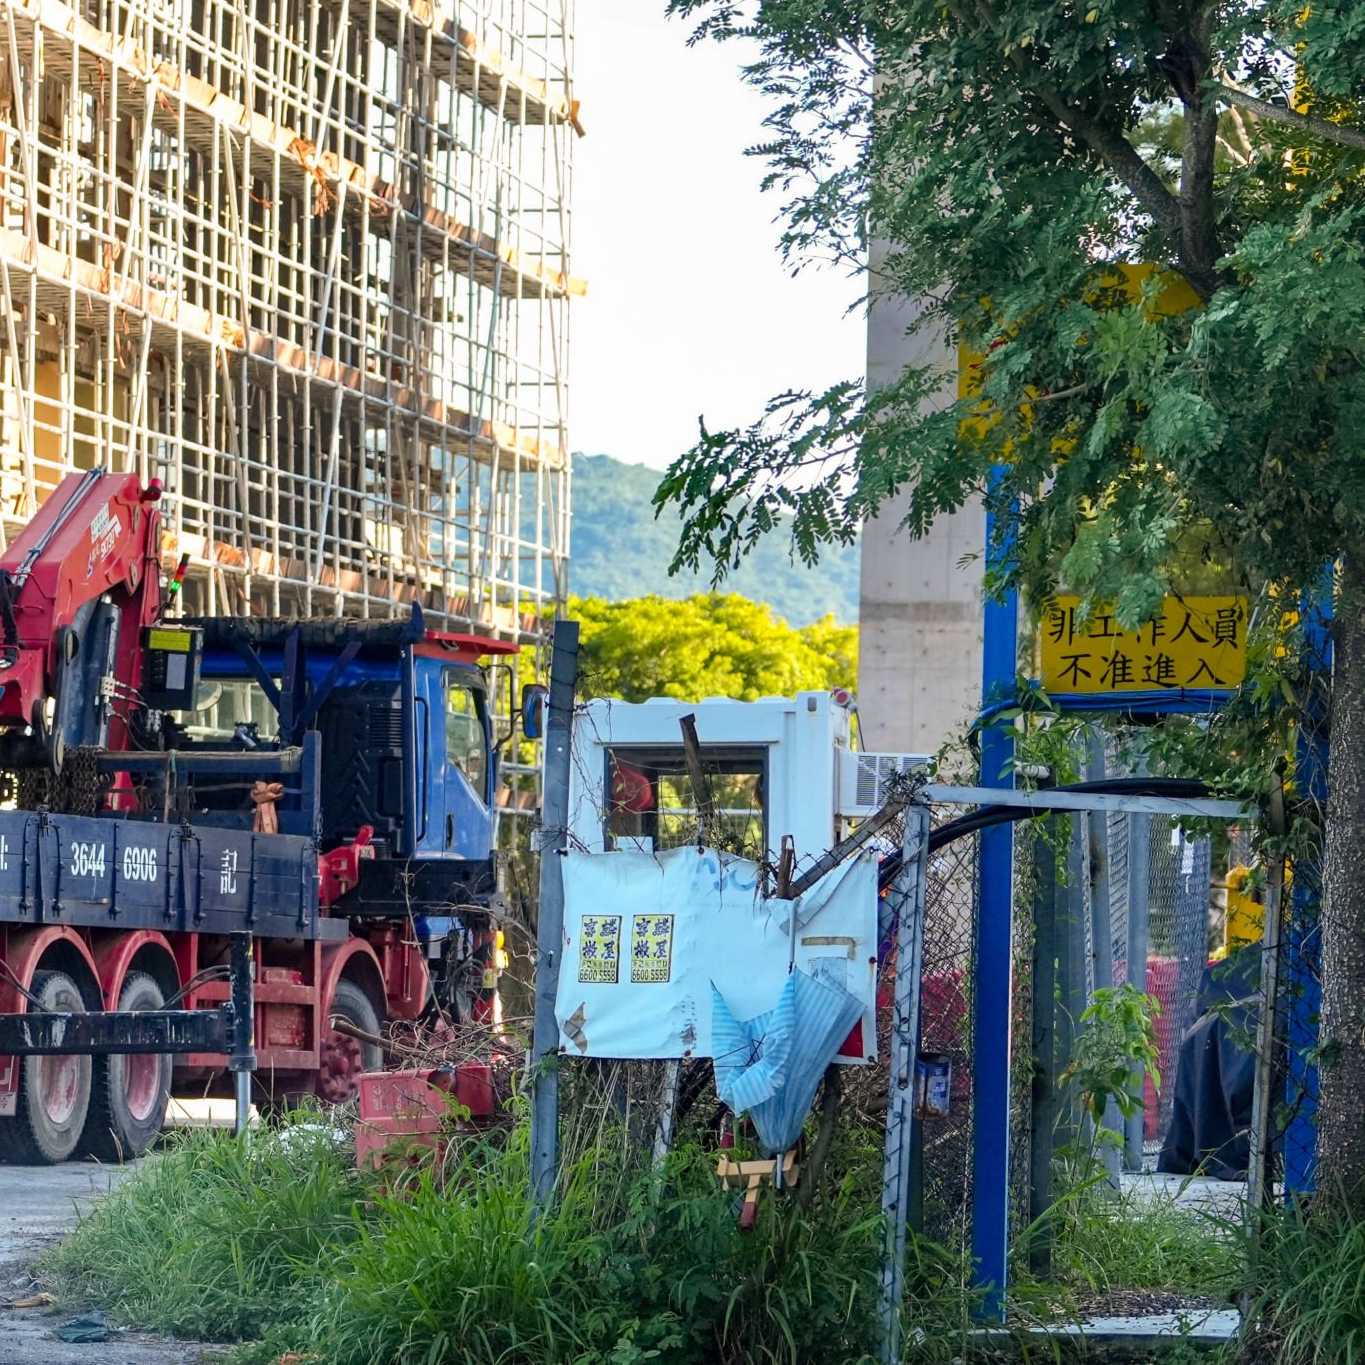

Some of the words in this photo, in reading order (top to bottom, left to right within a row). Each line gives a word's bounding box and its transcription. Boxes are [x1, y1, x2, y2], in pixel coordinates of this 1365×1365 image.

[1057, 650, 1227, 690] 不准進入
[71, 841, 105, 878] 3644
[123, 846, 157, 882] 6906
[220, 848, 237, 894] 記
[580, 969, 597, 981] 6600
